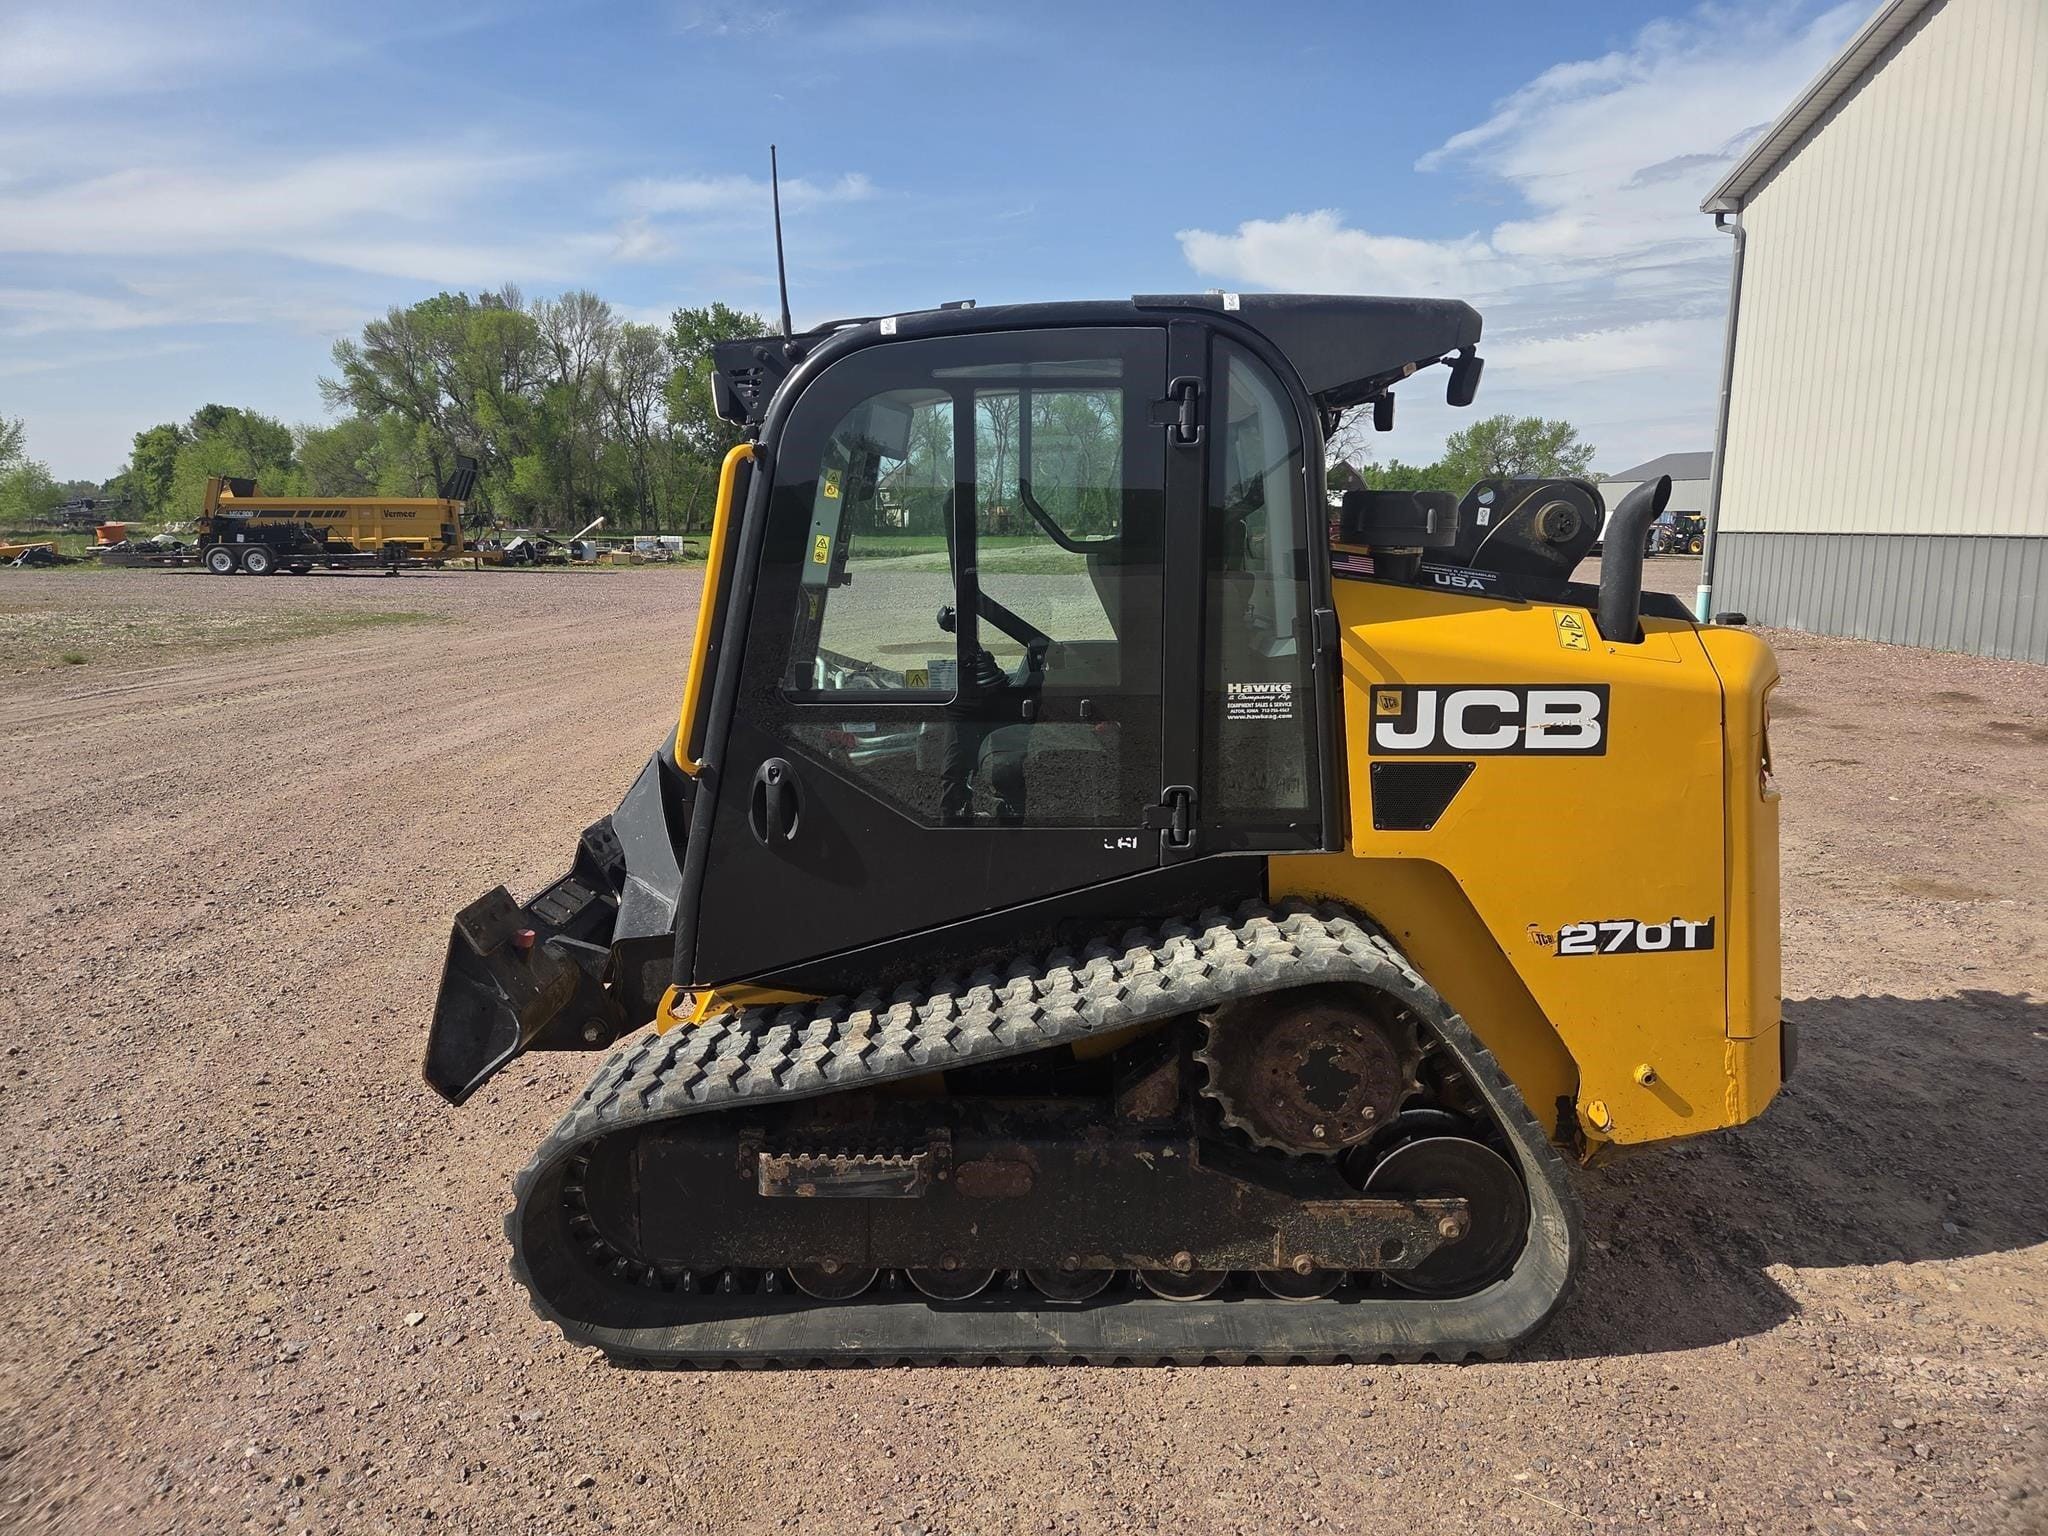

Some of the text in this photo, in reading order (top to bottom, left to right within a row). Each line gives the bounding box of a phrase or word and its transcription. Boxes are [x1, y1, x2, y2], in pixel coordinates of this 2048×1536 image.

[383, 509, 417, 519] Vermeer
[1434, 574, 1485, 590] USA
[1227, 683, 1292, 693] Hawke
[1237, 693, 1276, 701] Company
[1376, 690, 1602, 750] JCB
[1560, 920, 1709, 954] 270T
